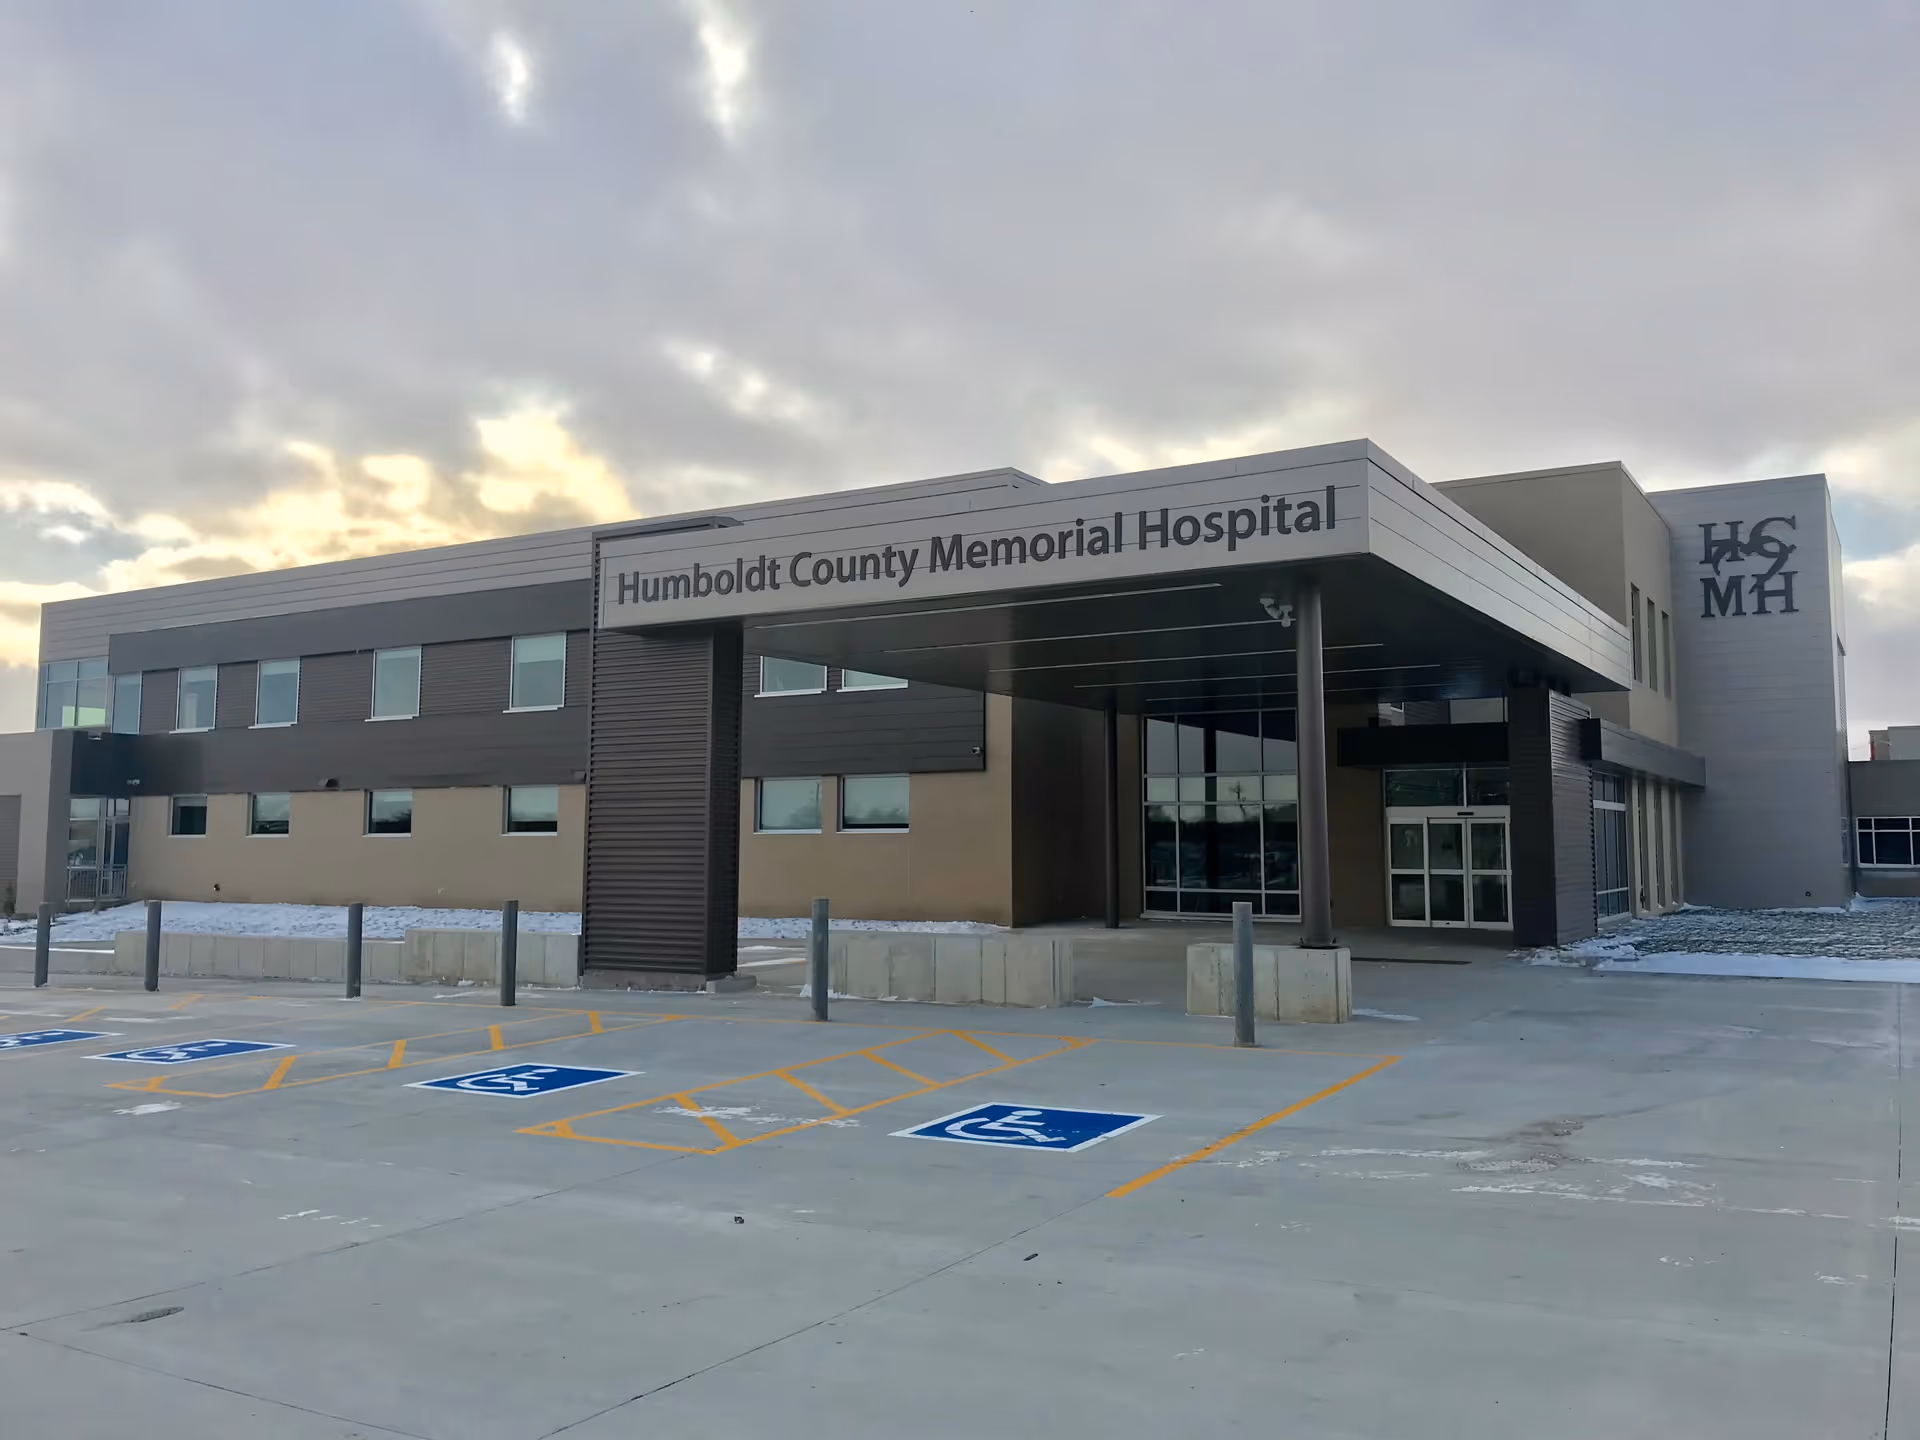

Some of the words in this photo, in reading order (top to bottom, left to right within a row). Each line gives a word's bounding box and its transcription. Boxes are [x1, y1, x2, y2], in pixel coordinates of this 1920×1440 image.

[618, 555, 780, 605] Humboldt
[789, 545, 919, 588] County
[929, 511, 1123, 574] Memorial
[1138, 485, 1336, 552] Hospital
[1699, 571, 1800, 618] MH
